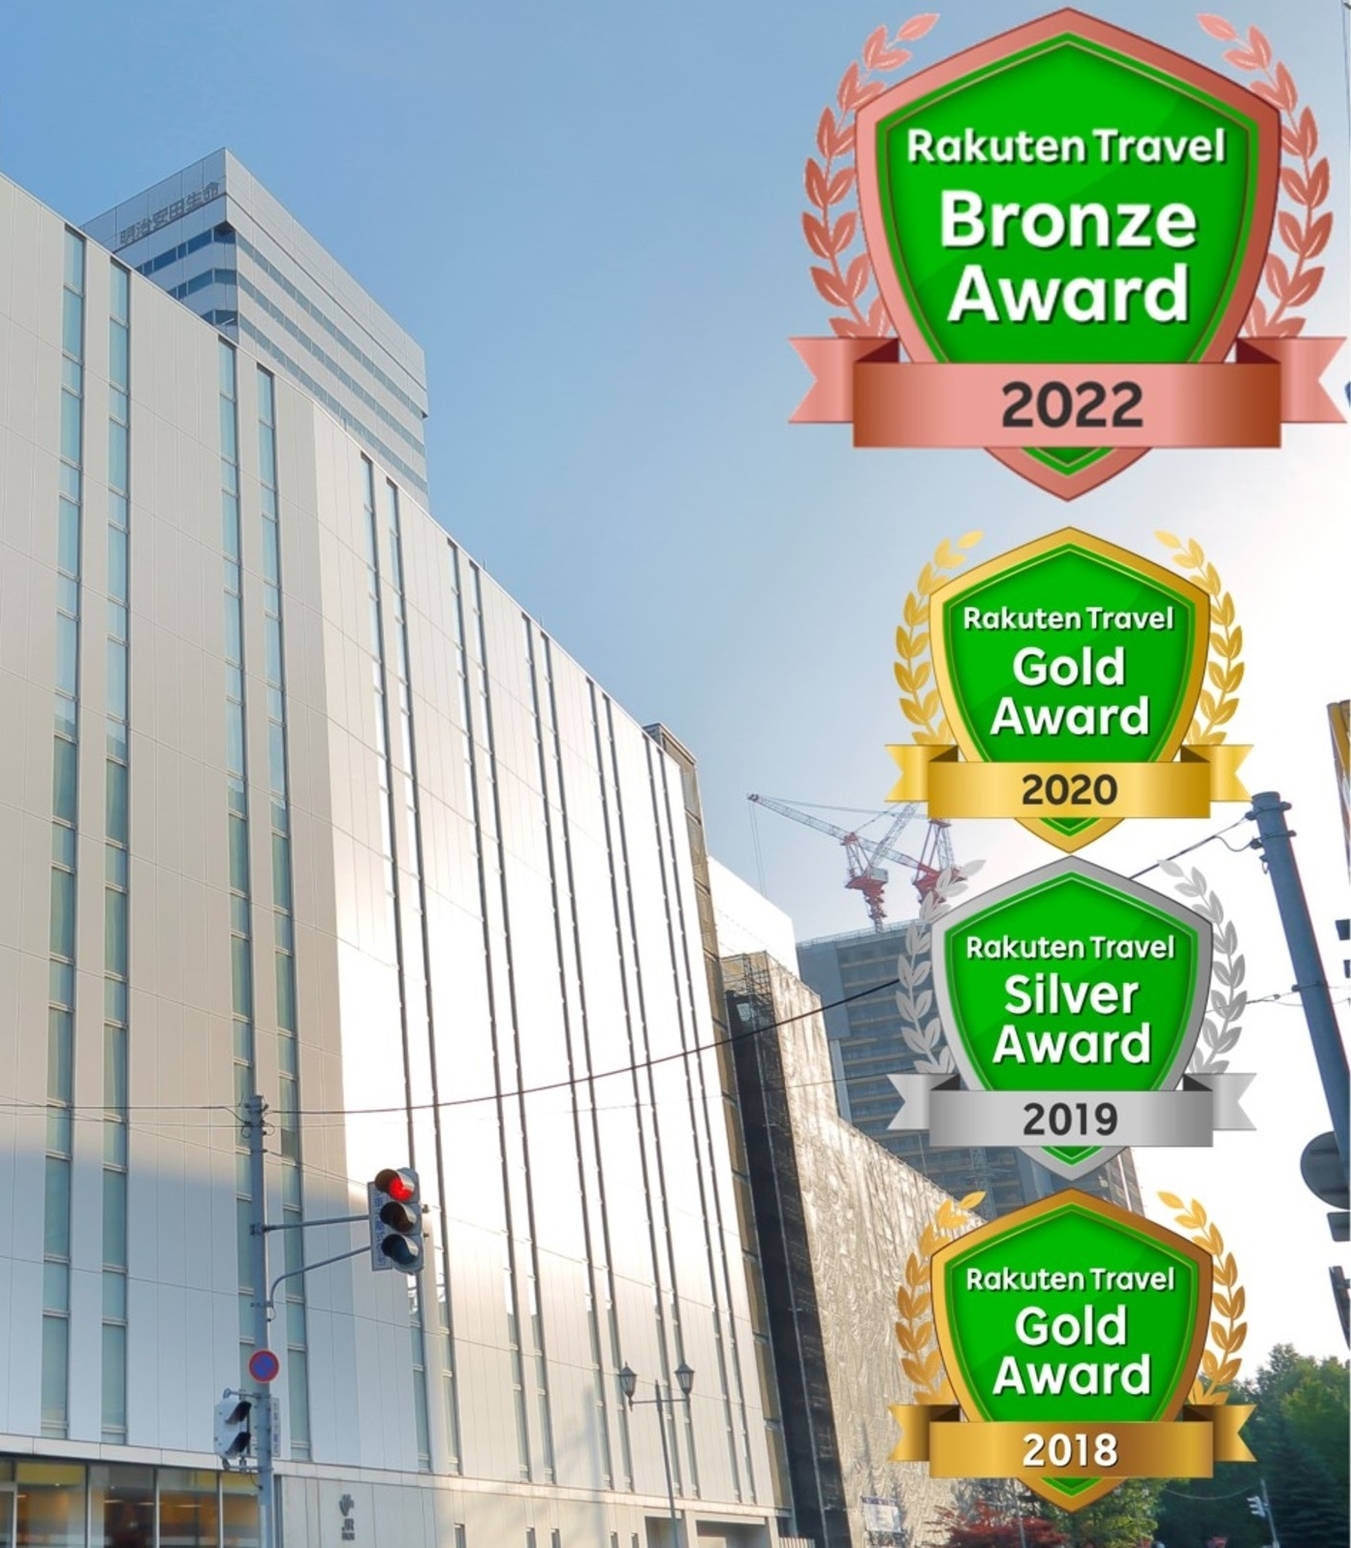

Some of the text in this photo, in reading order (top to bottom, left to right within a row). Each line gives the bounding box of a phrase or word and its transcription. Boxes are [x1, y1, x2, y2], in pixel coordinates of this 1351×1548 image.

[120, 181, 220, 244] 明治安田生命
